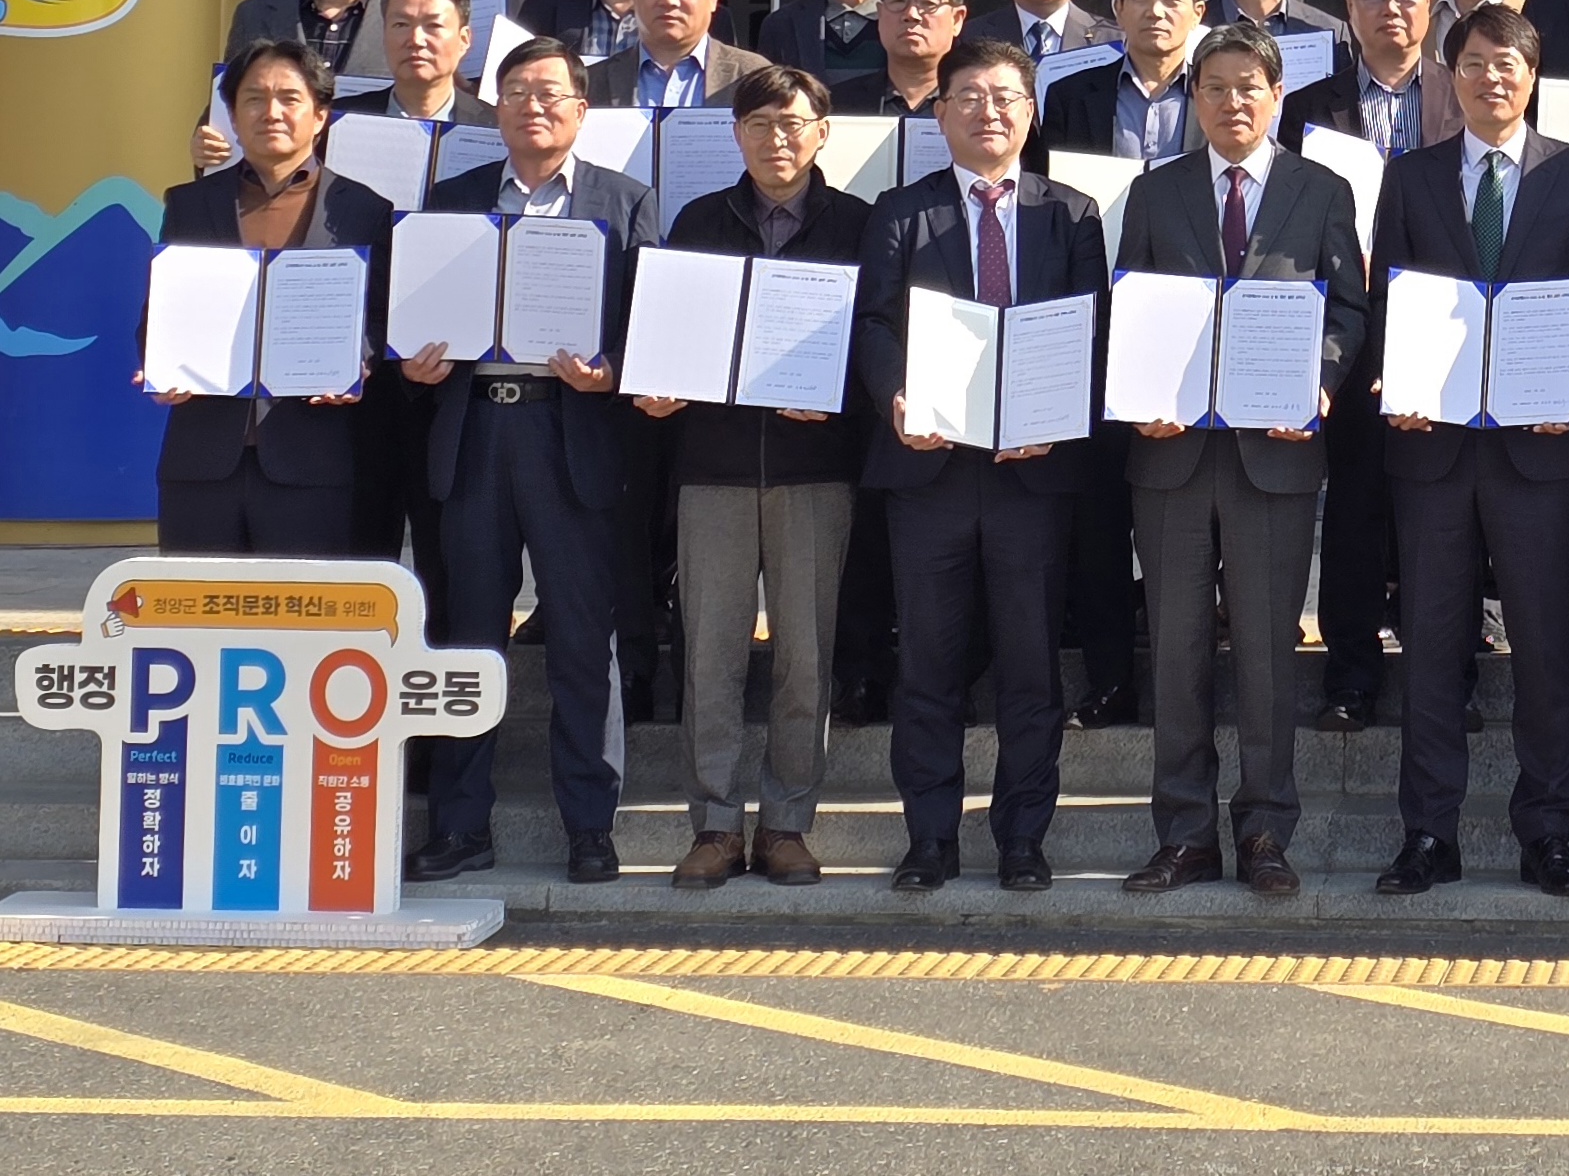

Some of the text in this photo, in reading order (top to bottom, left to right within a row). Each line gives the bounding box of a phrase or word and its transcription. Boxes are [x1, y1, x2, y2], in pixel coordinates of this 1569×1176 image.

[153, 595, 376, 618] 청양군 조직문화 혁신을 위한!
[34, 647, 482, 738] 행정 PRO 운동
[130, 750, 177, 763] Perfect
[228, 752, 274, 764] Reduce
[329, 754, 362, 767] Open
[332, 792, 352, 880] 공유하자
